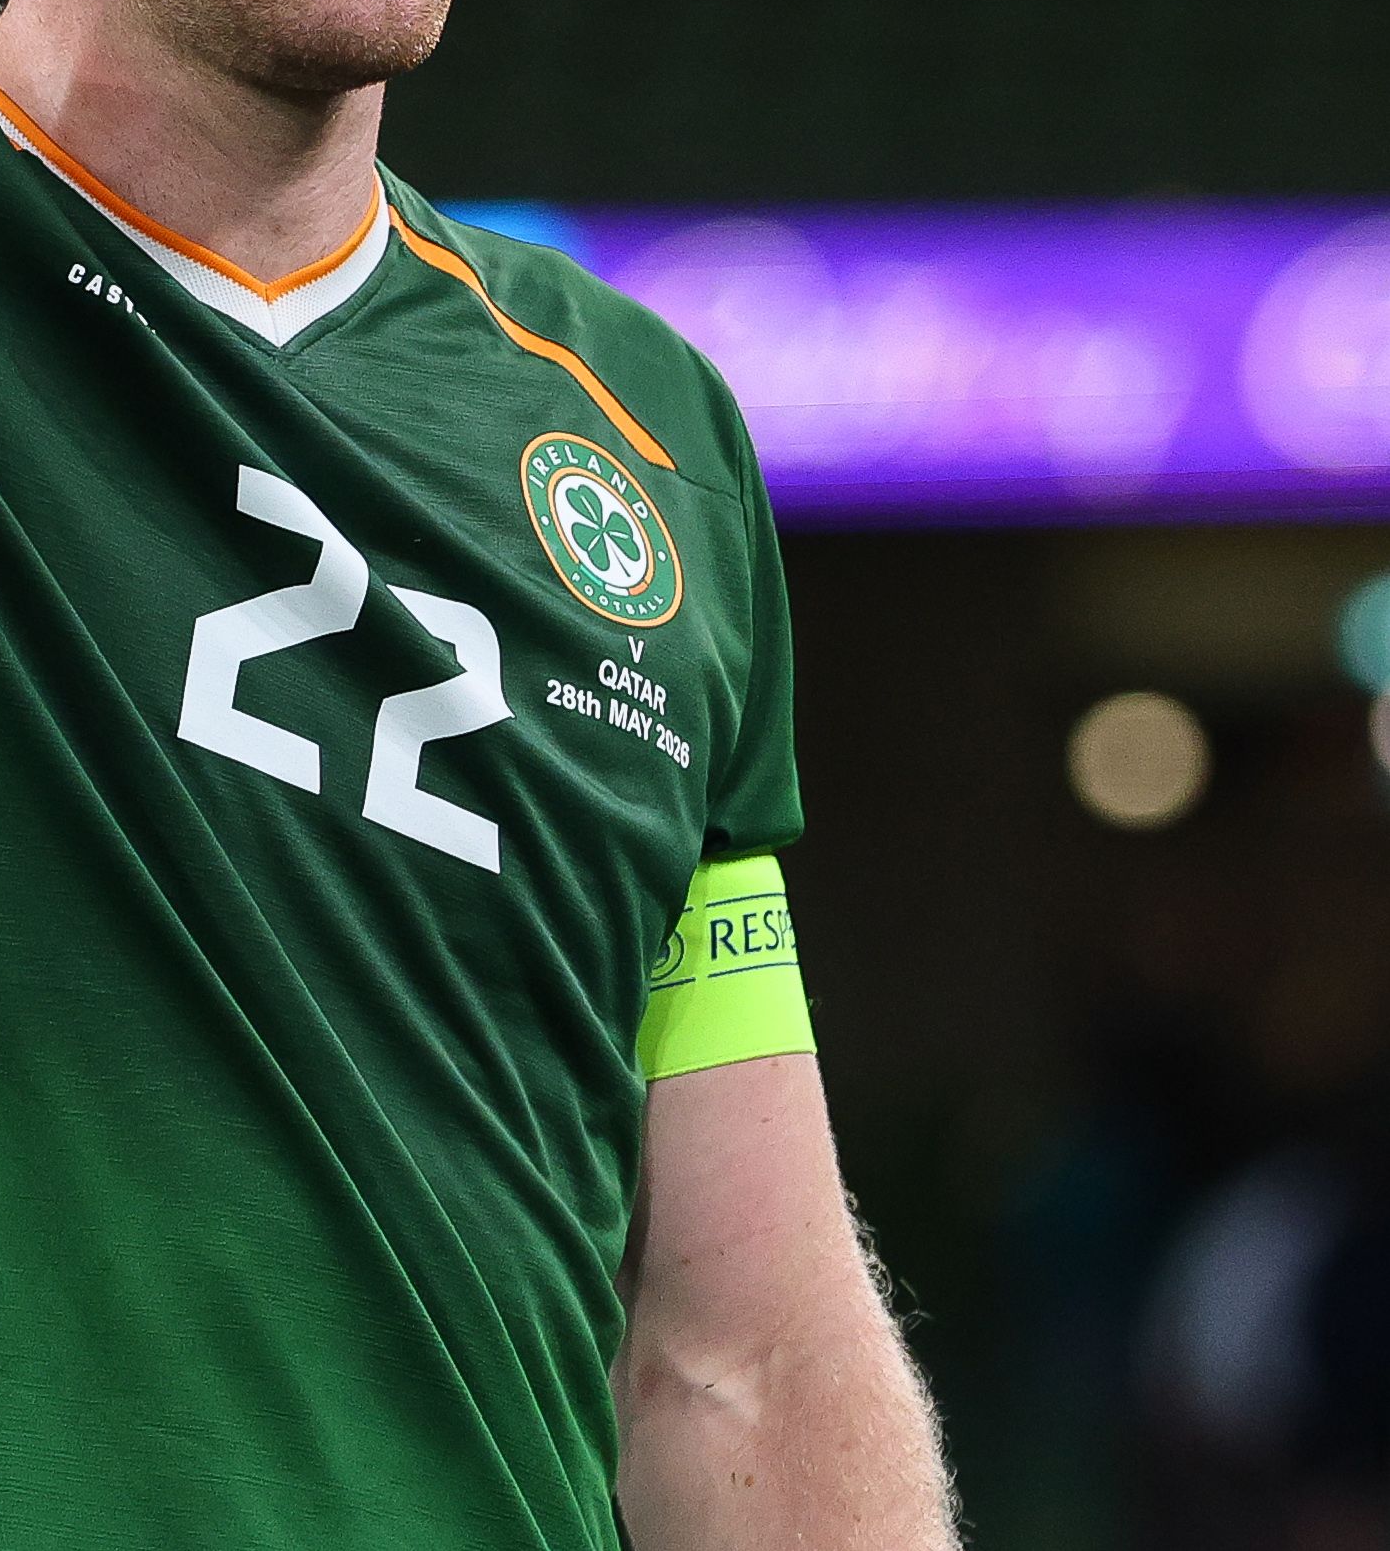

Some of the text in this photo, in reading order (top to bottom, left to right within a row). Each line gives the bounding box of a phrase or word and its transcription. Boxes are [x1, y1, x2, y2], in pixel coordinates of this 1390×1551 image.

[528, 444, 649, 520] IRELAND
[570, 571, 666, 617] FOOTBALL
[176, 464, 515, 875] 22
[627, 635, 645, 663] V
[598, 659, 666, 716] QATAR
[546, 679, 690, 769] 28th MAY 2026
